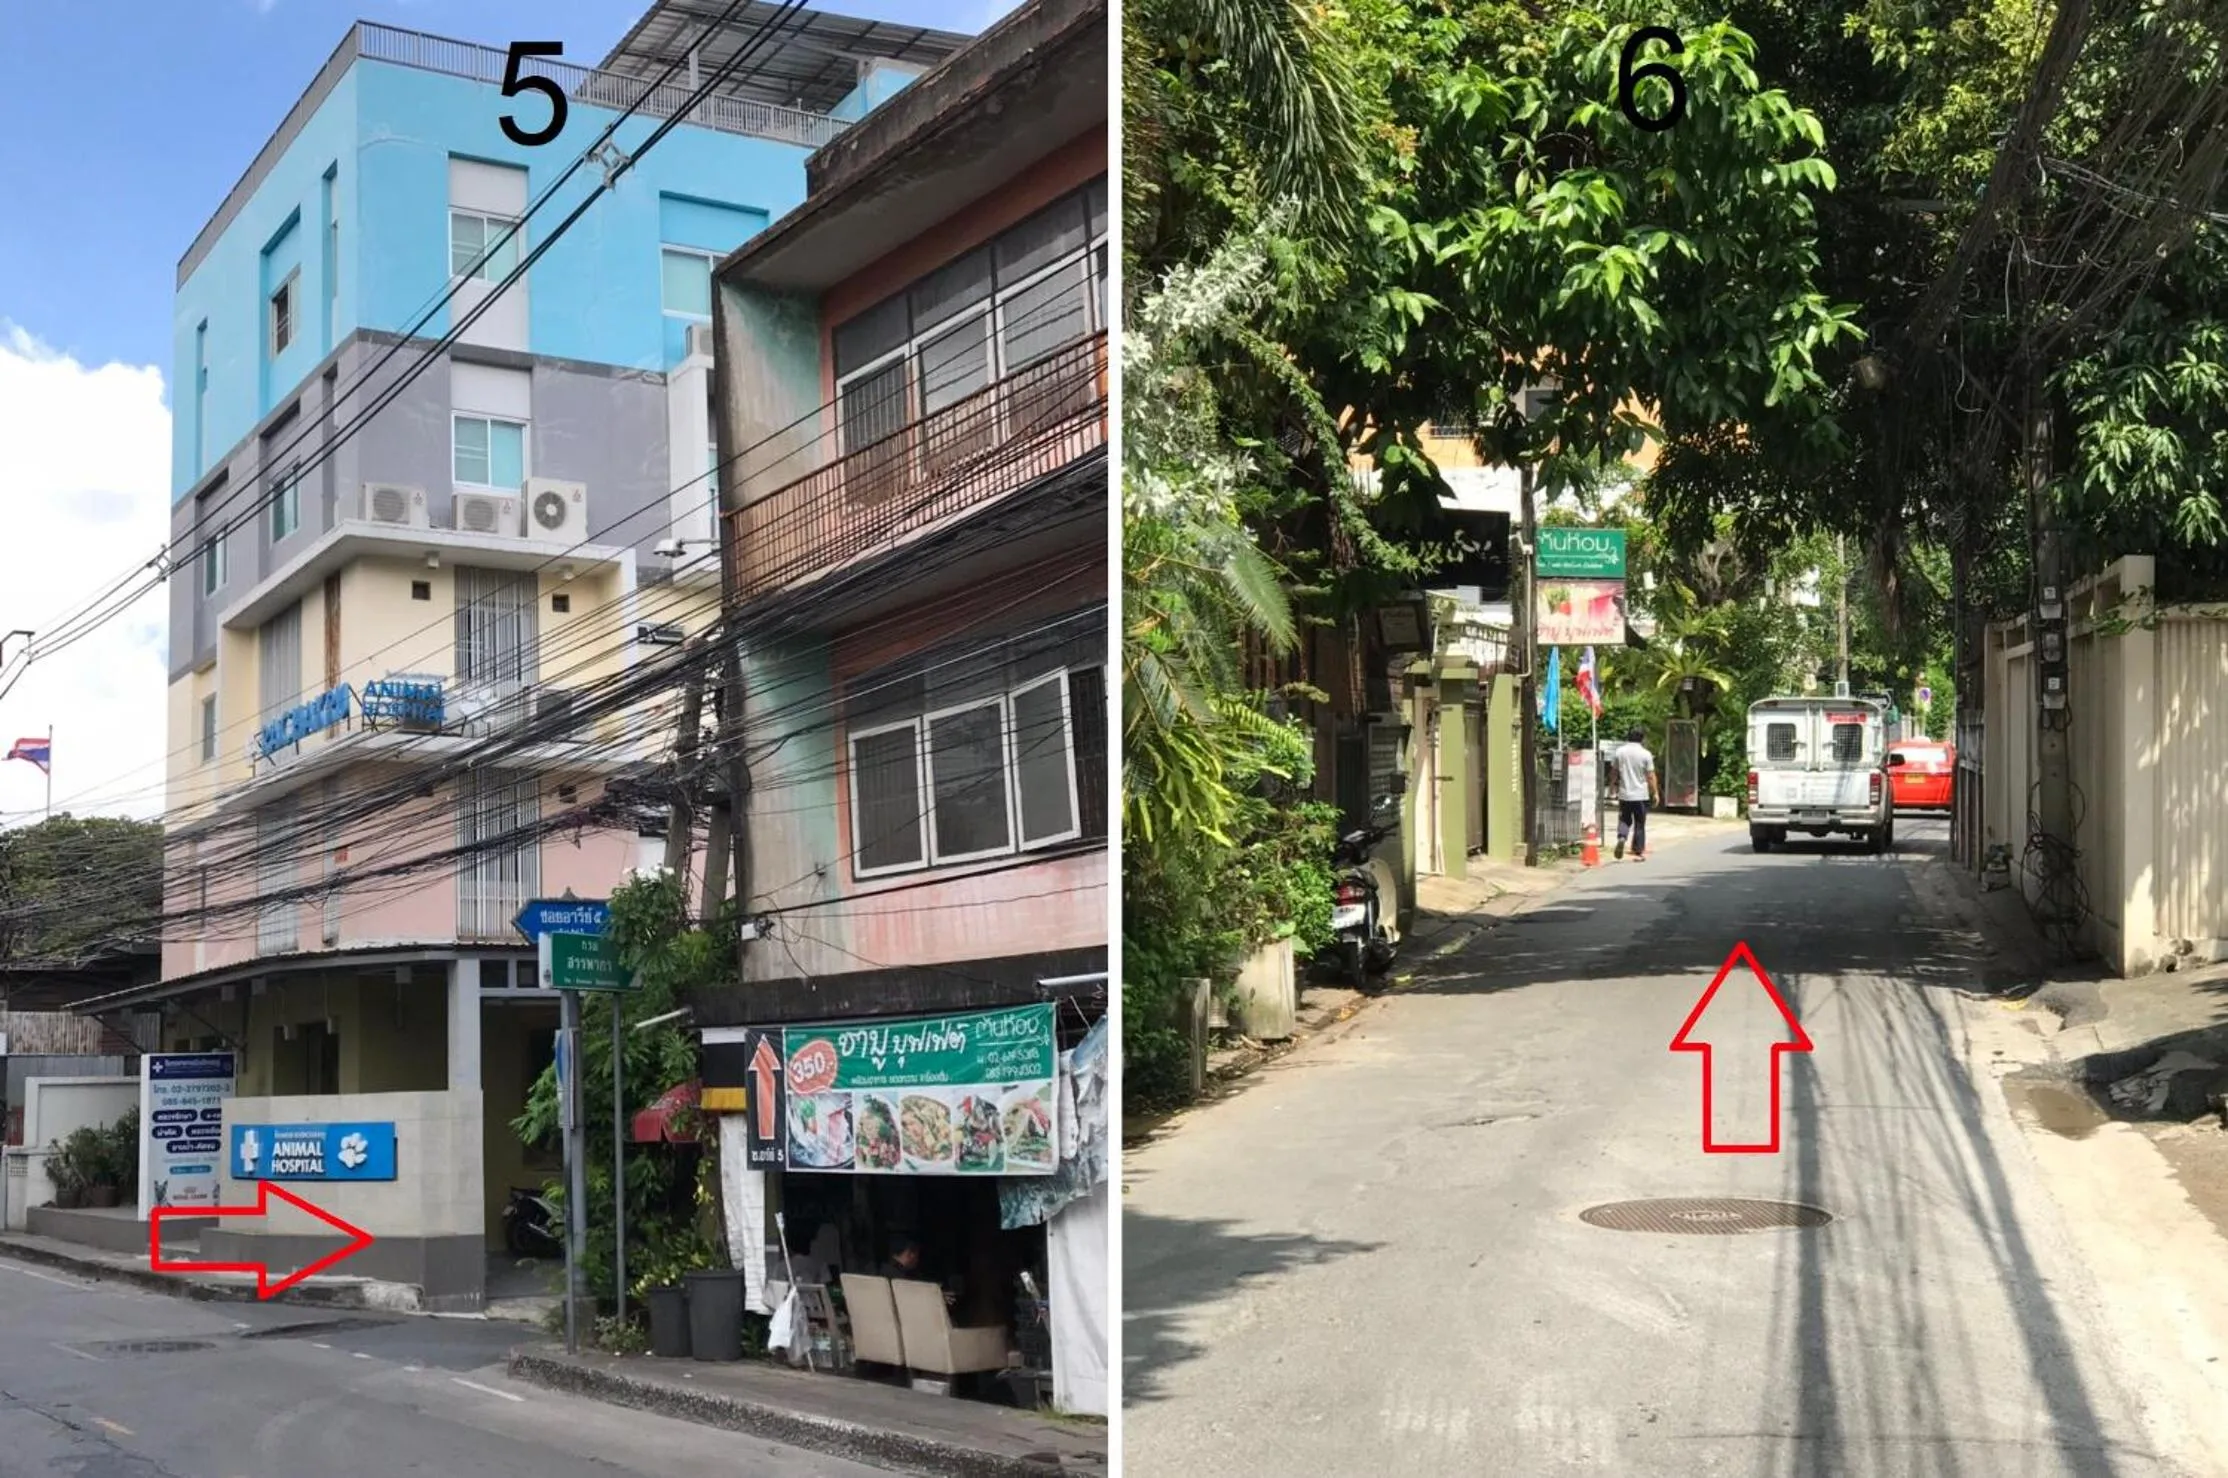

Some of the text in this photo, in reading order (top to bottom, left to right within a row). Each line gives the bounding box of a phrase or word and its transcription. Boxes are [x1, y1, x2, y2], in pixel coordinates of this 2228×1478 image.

[838, 1026, 889, 1072] ชาบู
[272, 1141, 324, 1157] ANIMAL
[271, 1158, 325, 1174] HOSPITAL
